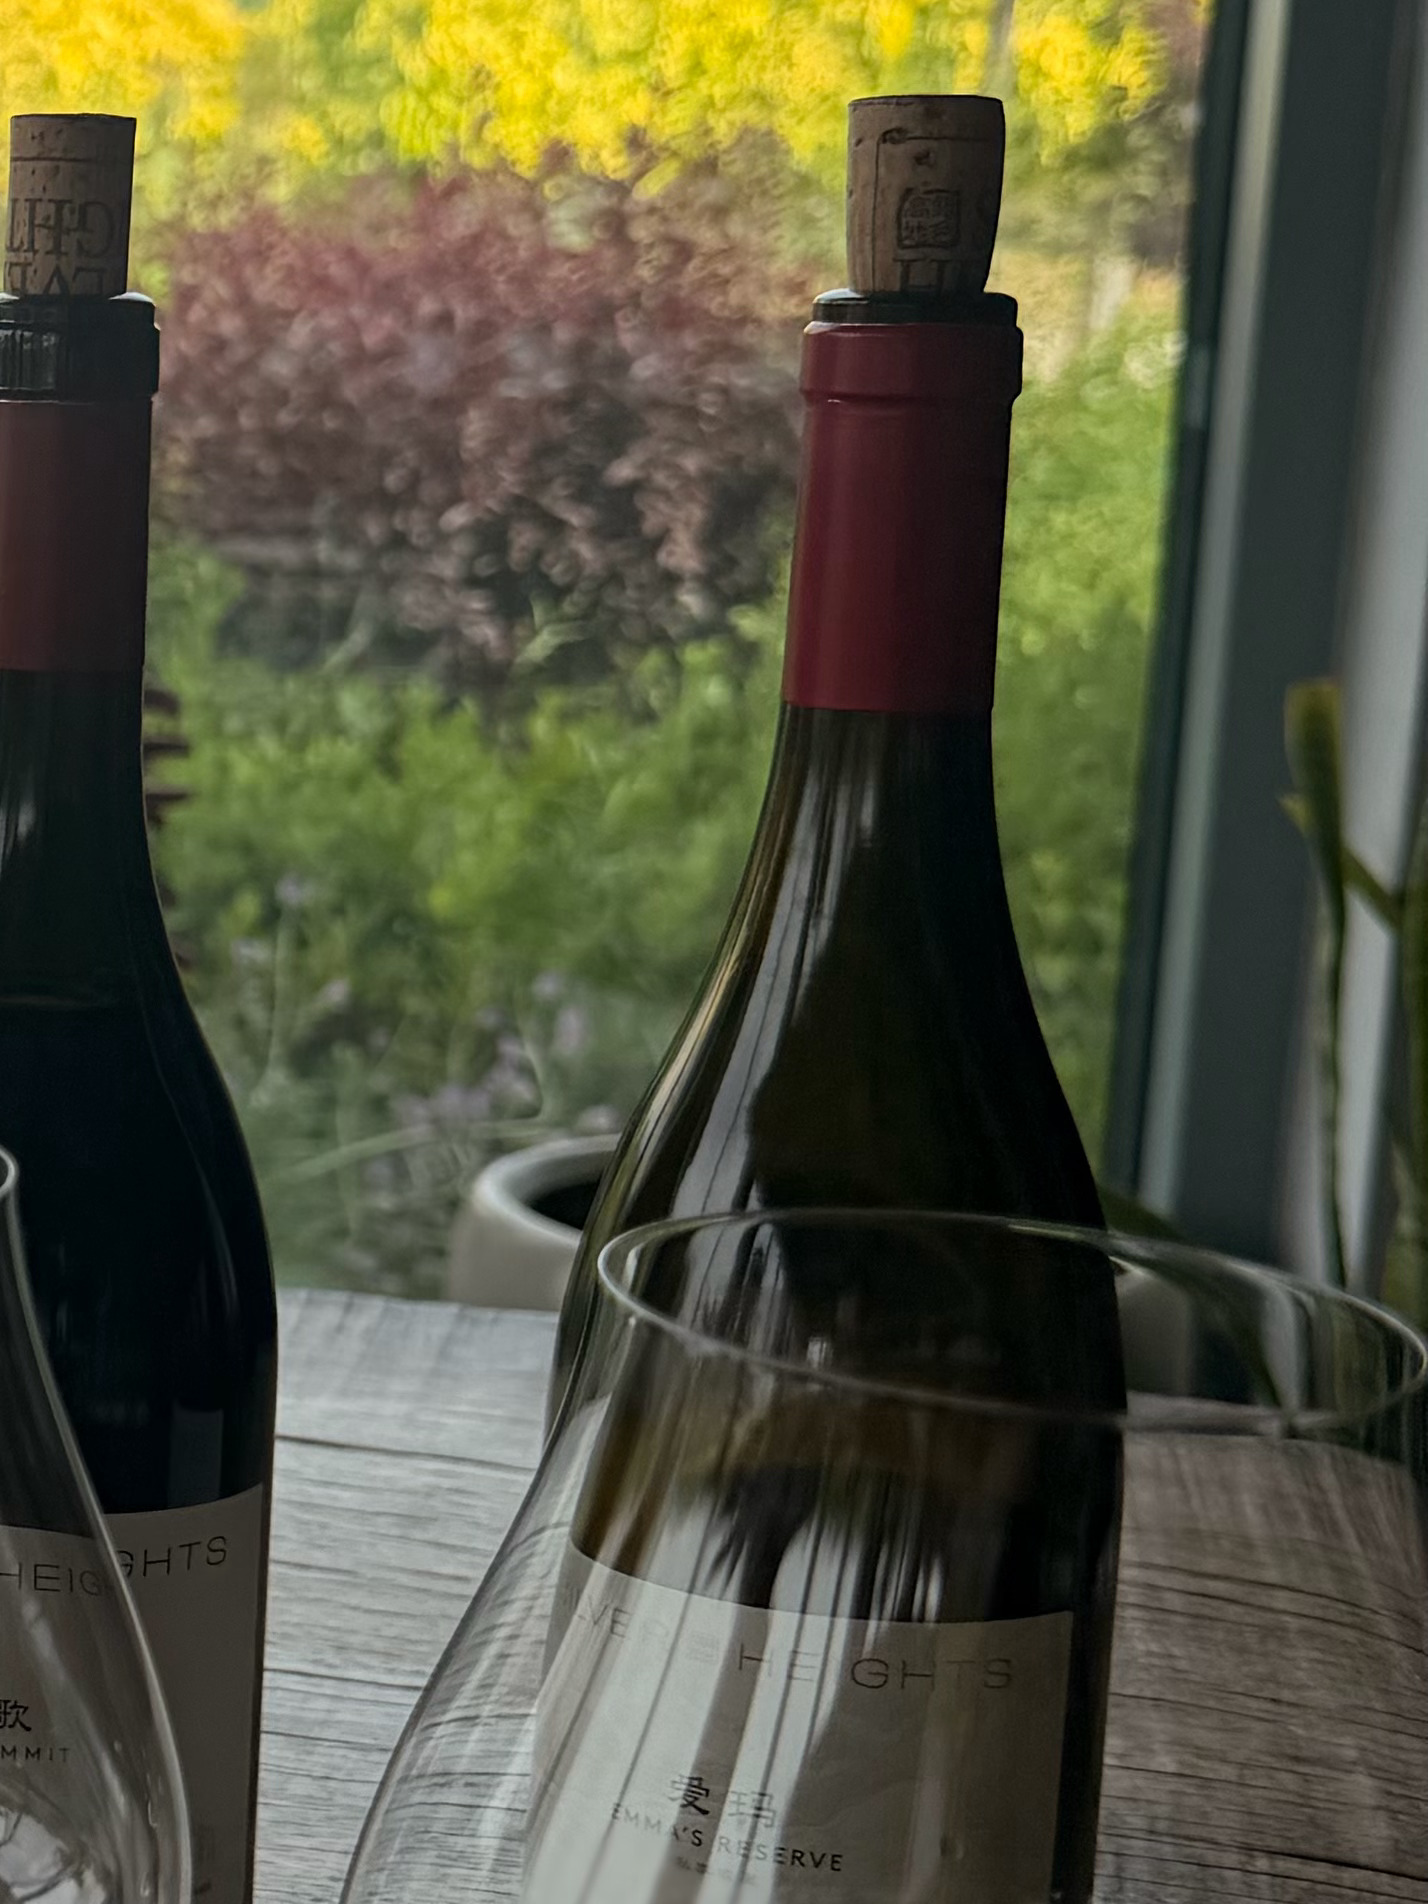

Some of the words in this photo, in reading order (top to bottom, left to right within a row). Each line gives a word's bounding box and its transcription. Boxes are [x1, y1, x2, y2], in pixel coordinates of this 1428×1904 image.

[738, 1642, 1013, 1691] HEGHTS
[612, 1802, 704, 1848] EMMA'S
[717, 1835, 844, 1873] RESERVE
